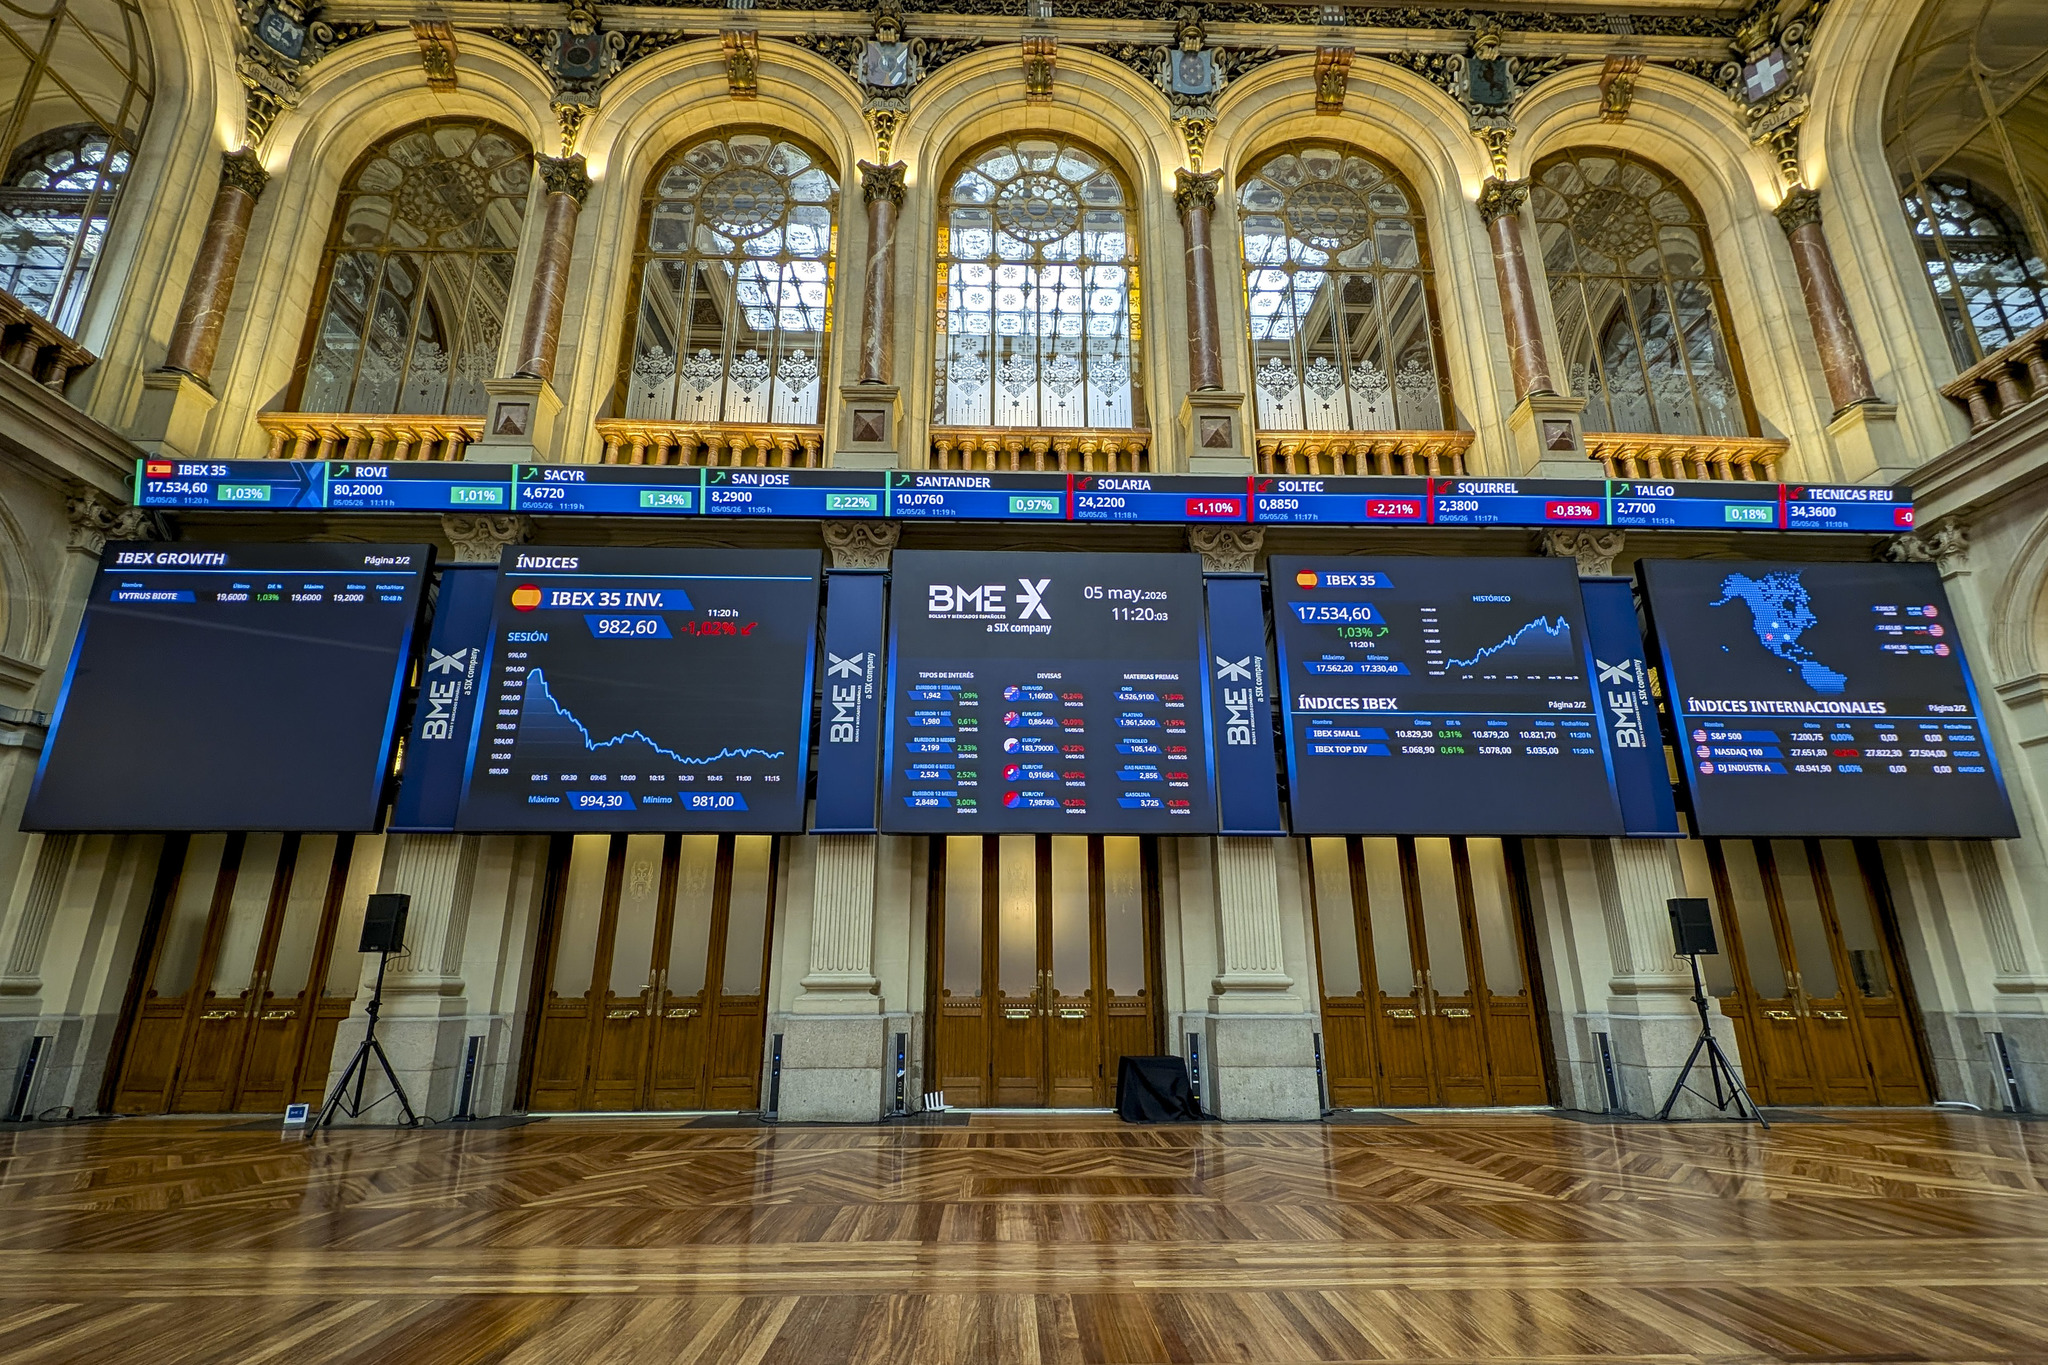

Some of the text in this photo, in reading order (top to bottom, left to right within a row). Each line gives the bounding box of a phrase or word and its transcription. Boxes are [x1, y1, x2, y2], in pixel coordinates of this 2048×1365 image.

[872, 100, 902, 108] SUECIA
[1762, 106, 1796, 130] SUIZA
[178, 464, 226, 476] IBEX 35
[355, 467, 388, 478] ROVI
[544, 469, 585, 482] SACYR
[731, 473, 790, 486] SAN JOSE
[916, 476, 991, 489] SANTANDER
[1097, 479, 1151, 491] SOLARIA
[147, 482, 208, 494] 17.534,60
[333, 484, 383, 497] 80,2000
[1278, 480, 1324, 493] SOLTEC
[1458, 482, 1519, 495] SQUIRREL
[1635, 485, 1675, 497] TALGO
[145, 496, 177, 504] 05/05/26
[225, 488, 263, 500] 1,03%
[458, 489, 496, 502] 1,01%
[523, 487, 565, 501] 4,6720
[648, 493, 685, 507] 1,34%
[712, 490, 753, 504] 8,2900
[897, 493, 944, 507] 10,0760
[1808, 488, 1894, 501] TECNICAS REU
[522, 502, 553, 510] 05/05/26
[560, 502, 577, 510] 11:19
[833, 496, 871, 510] 2,22%
[1016, 499, 1053, 512] 0,97%
[1078, 496, 1126, 509] 24,2200
[1192, 501, 1234, 514] -1,10%
[1259, 498, 1299, 511] 0,8850
[1439, 500, 1479, 513] 2,3800
[1617, 503, 1657, 515] 2,7700
[896, 508, 956, 516] 05/05/26 11:19 h
[1372, 503, 1414, 516] -2,21%
[1552, 504, 1593, 518] -0,83%
[1731, 508, 1767, 521] 0,18%
[1791, 506, 1837, 518] 34,3600
[116, 552, 226, 566] IBEX GROWTH
[364, 555, 410, 566] Página 2/2
[516, 553, 578, 569] ÍNDICES
[1326, 575, 1376, 586] IBEX 35
[118, 592, 178, 600] VYTRUS BIOTE
[216, 593, 364, 602] 19,6000 1,03% 19,6000 19,2000
[551, 591, 664, 607] IBEX 35 INV.
[928, 584, 1006, 612] BME
[1083, 585, 1103, 600] 05
[1472, 594, 1511, 602] HISTÓRICO
[707, 609, 739, 618] 11:20 h
[1298, 607, 1371, 622] 17.534,60
[598, 619, 658, 636] 982,60
[681, 622, 737, 637] -1,02%
[986, 623, 1052, 635] a SIX company
[1336, 627, 1373, 638] 1,03%
[507, 630, 548, 642] SESIÓN
[467, 647, 480, 679] company
[866, 652, 876, 682] company
[1316, 664, 1398, 673] 17.562,20 17.330,40
[948, 670, 974, 679] INTERÉS
[1037, 672, 1062, 680] DIVISAS
[464, 678, 473, 691] SIX
[864, 682, 873, 694] SIX
[1298, 694, 1398, 710] ÍNDICES IBEX
[1548, 700, 1587, 710] Página 2/2
[1688, 697, 1887, 715] ÍNDICES INTERNACIONALES
[422, 681, 456, 739] BME
[830, 684, 856, 743] BME
[1224, 688, 1251, 745] BME
[1607, 691, 1641, 748] BME
[1313, 730, 1557, 740] IBEX SMALL 10.829,30 0,31% 10.879,20 10.821,70
[1710, 732, 1727, 740] S&P
[920, 744, 940, 752] 2,199
[1334, 746, 1350, 754] TOP
[1351, 746, 1368, 754] DIV
[1402, 746, 1435, 755] 5.068,90
[1479, 746, 1512, 755] 5.078,00
[1526, 746, 1559, 755] 5.035,00
[1714, 748, 1747, 757] NASDAQ
[1748, 748, 1763, 756] 100
[920, 771, 939, 779] 2,524
[1718, 764, 1727, 773] DJ
[1139, 772, 1158, 780] 2,856
[528, 795, 734, 808] Máximo 994,30 Mínimo 981,00
[1140, 799, 1159, 807] 3,725
